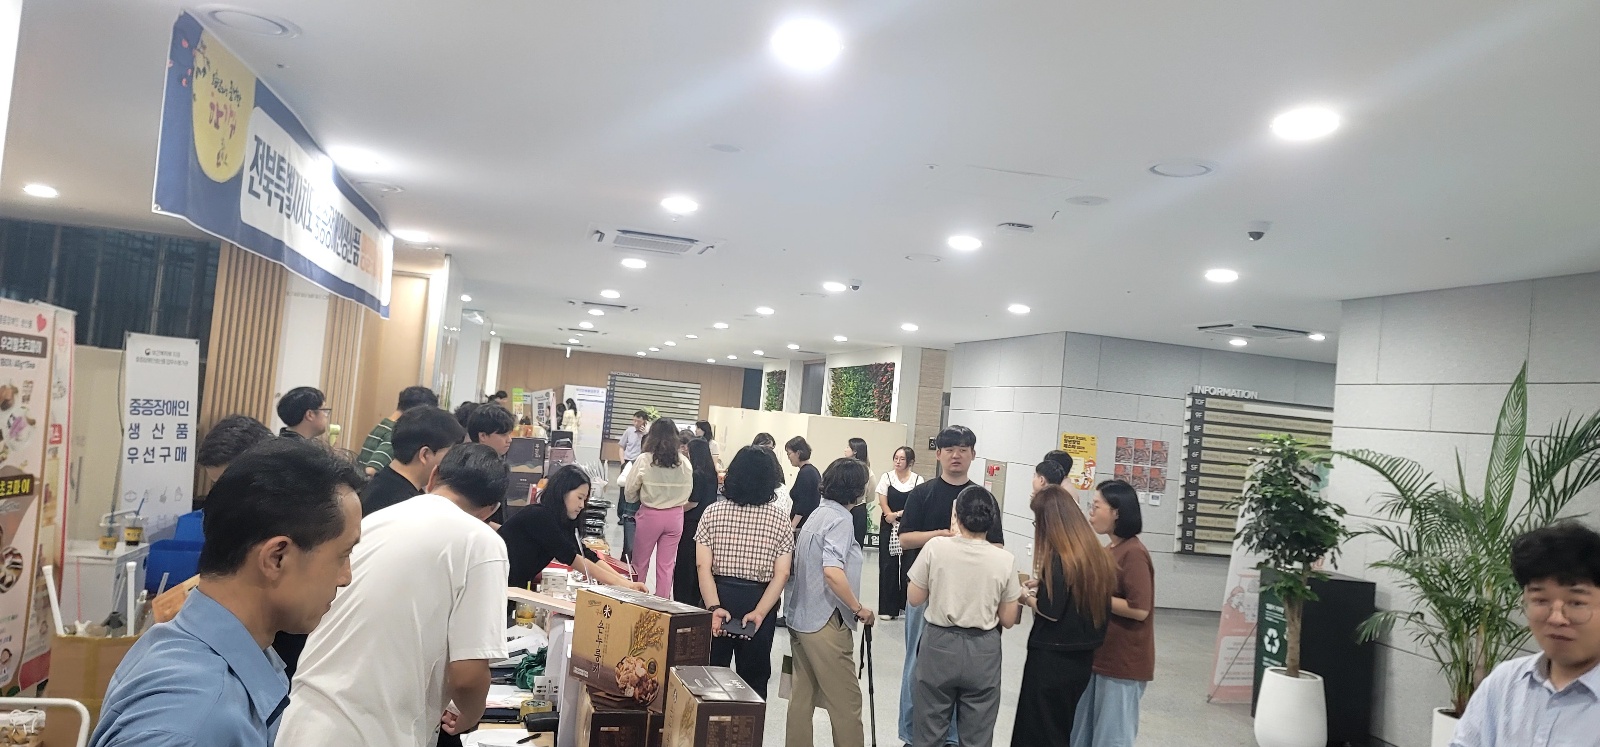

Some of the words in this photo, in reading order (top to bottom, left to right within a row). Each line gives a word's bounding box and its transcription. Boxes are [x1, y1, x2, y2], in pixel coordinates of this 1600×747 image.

[1194, 385, 1258, 399] INFORMATION
[129, 398, 190, 417] 중증장애인
[1187, 503, 1196, 511] 2F
